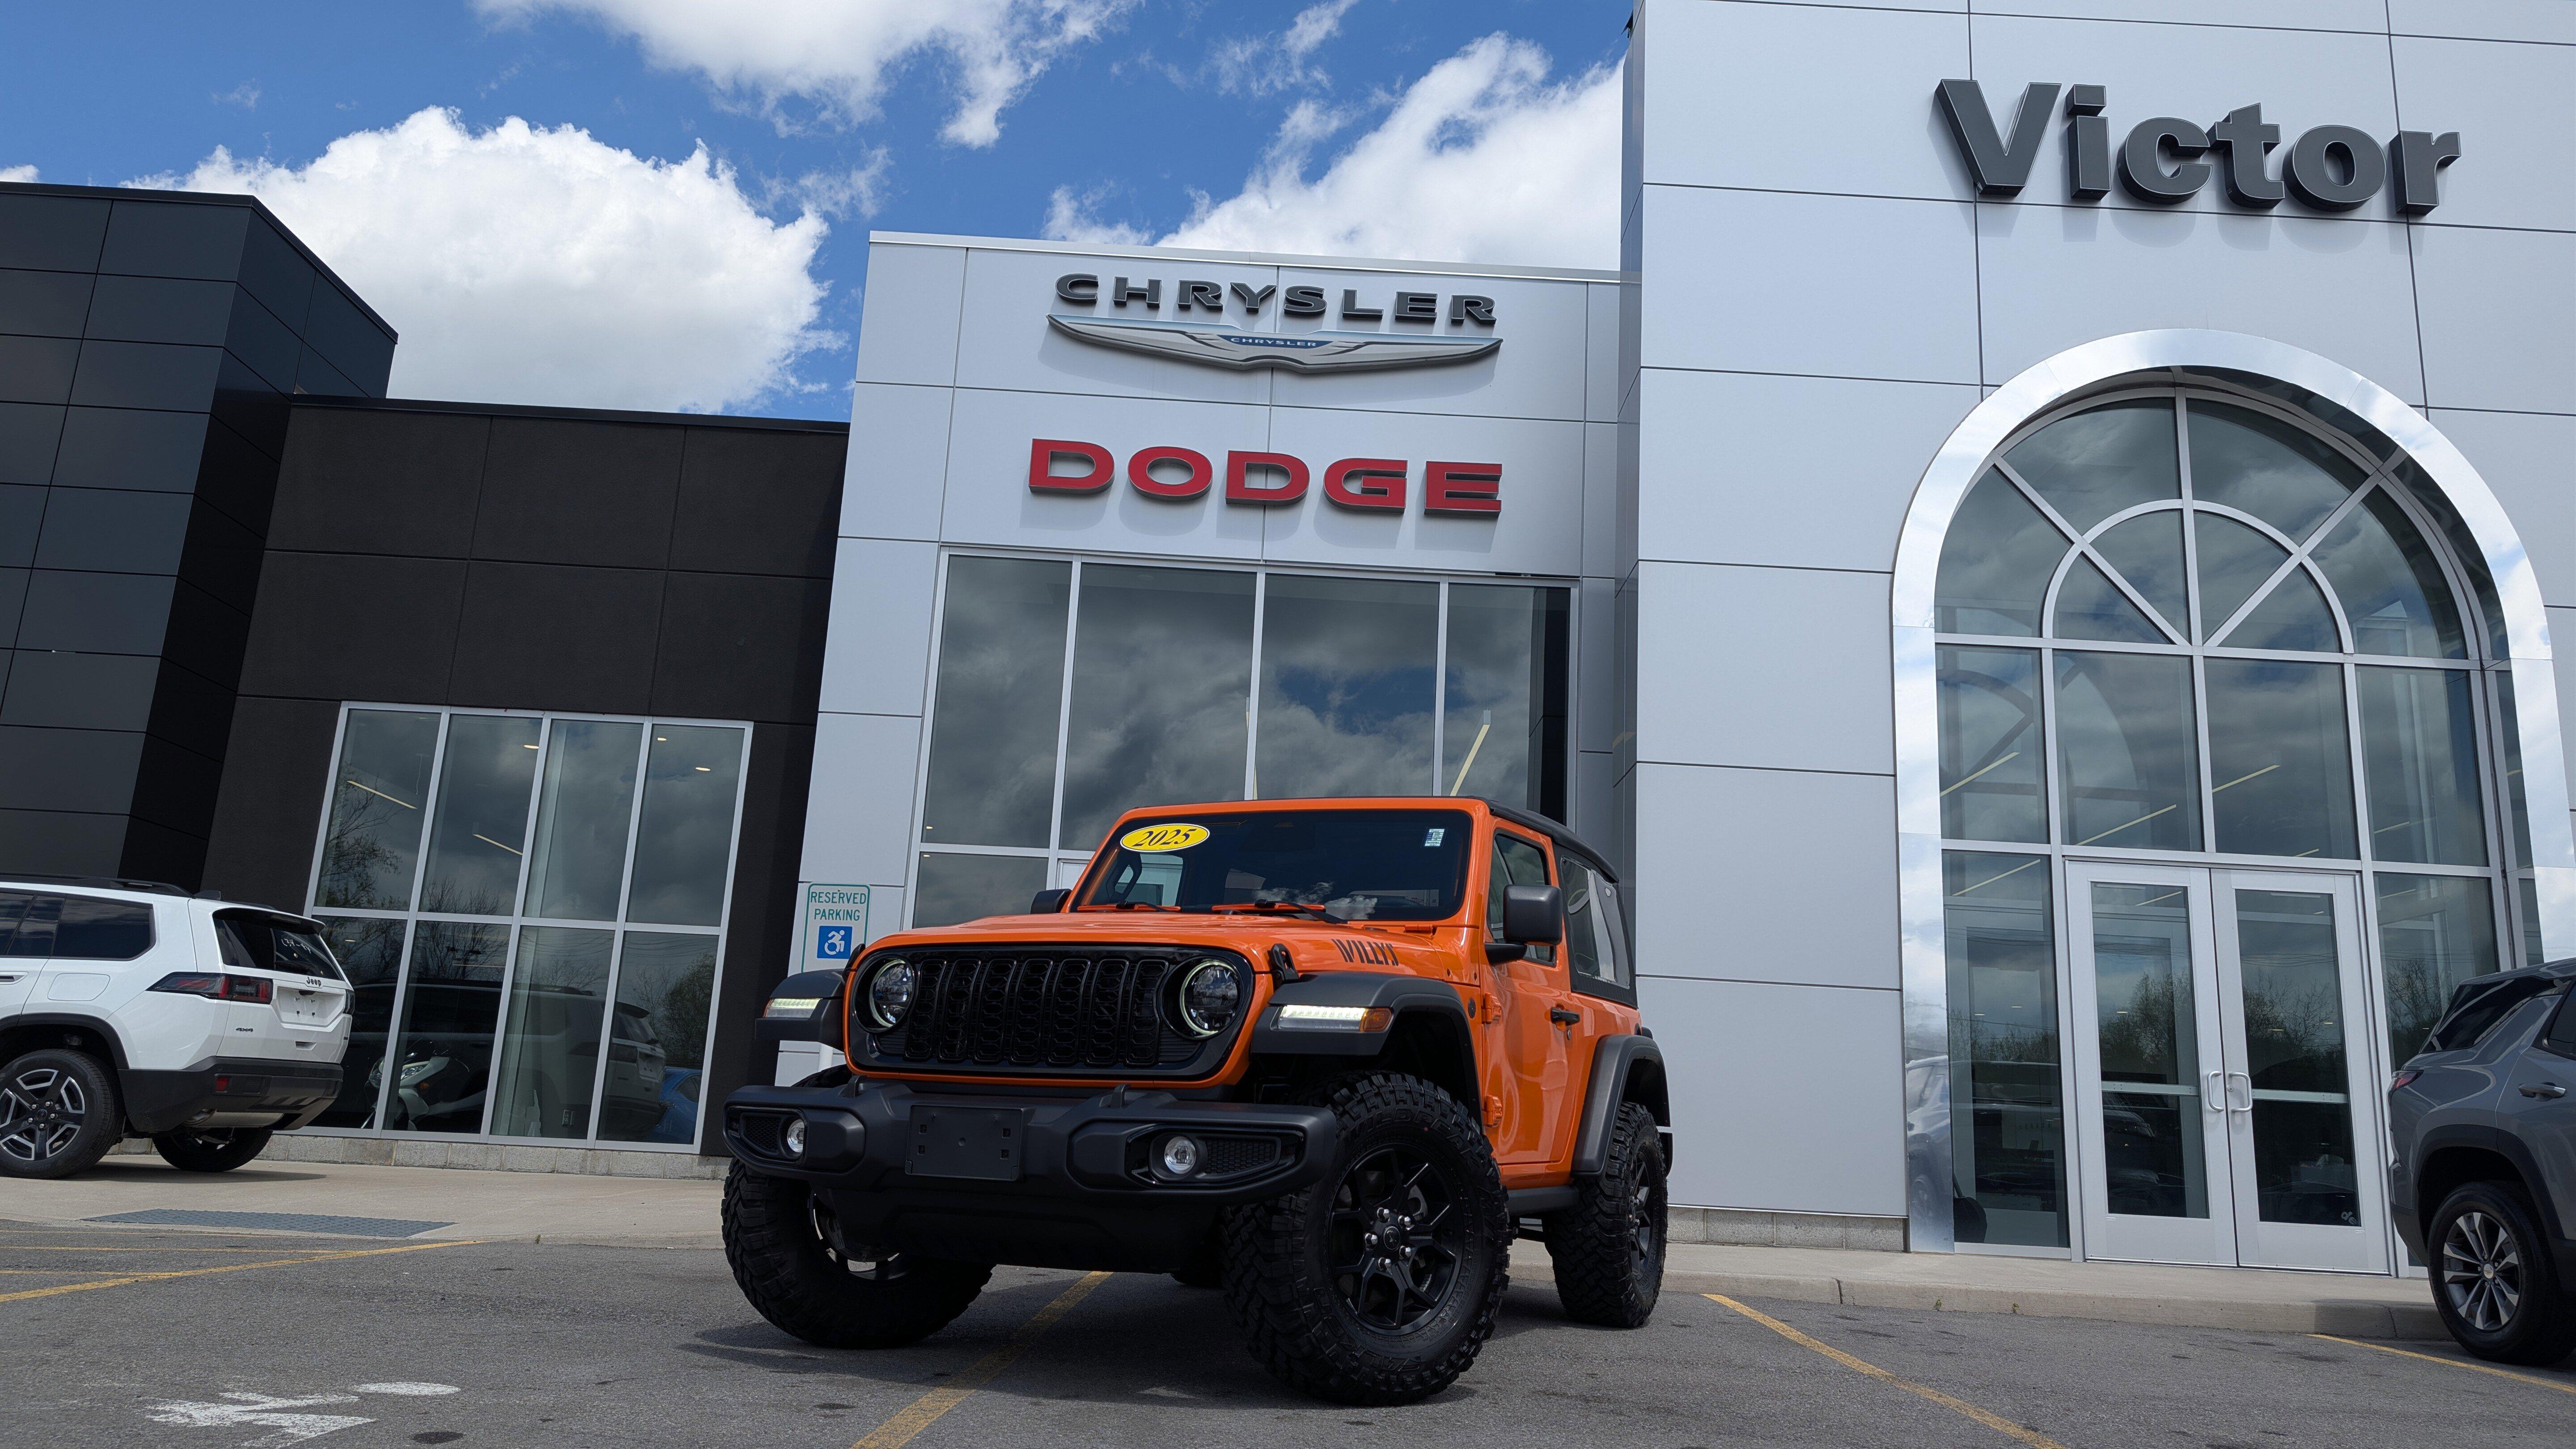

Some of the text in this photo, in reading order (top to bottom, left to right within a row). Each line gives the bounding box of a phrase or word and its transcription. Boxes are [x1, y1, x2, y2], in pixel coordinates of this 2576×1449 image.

[1936, 79, 2461, 216] Victor
[1055, 273, 1497, 326] CHRYSLER
[1230, 338, 1316, 347] CHRYSLER
[1029, 438, 1502, 518] DODGE
[1131, 828, 1197, 847] 2025
[810, 891, 867, 904] RESERVED
[814, 908, 860, 921] PARKING
[1331, 939, 1399, 966] WILLYS
[306, 977, 322, 987] Jeep
